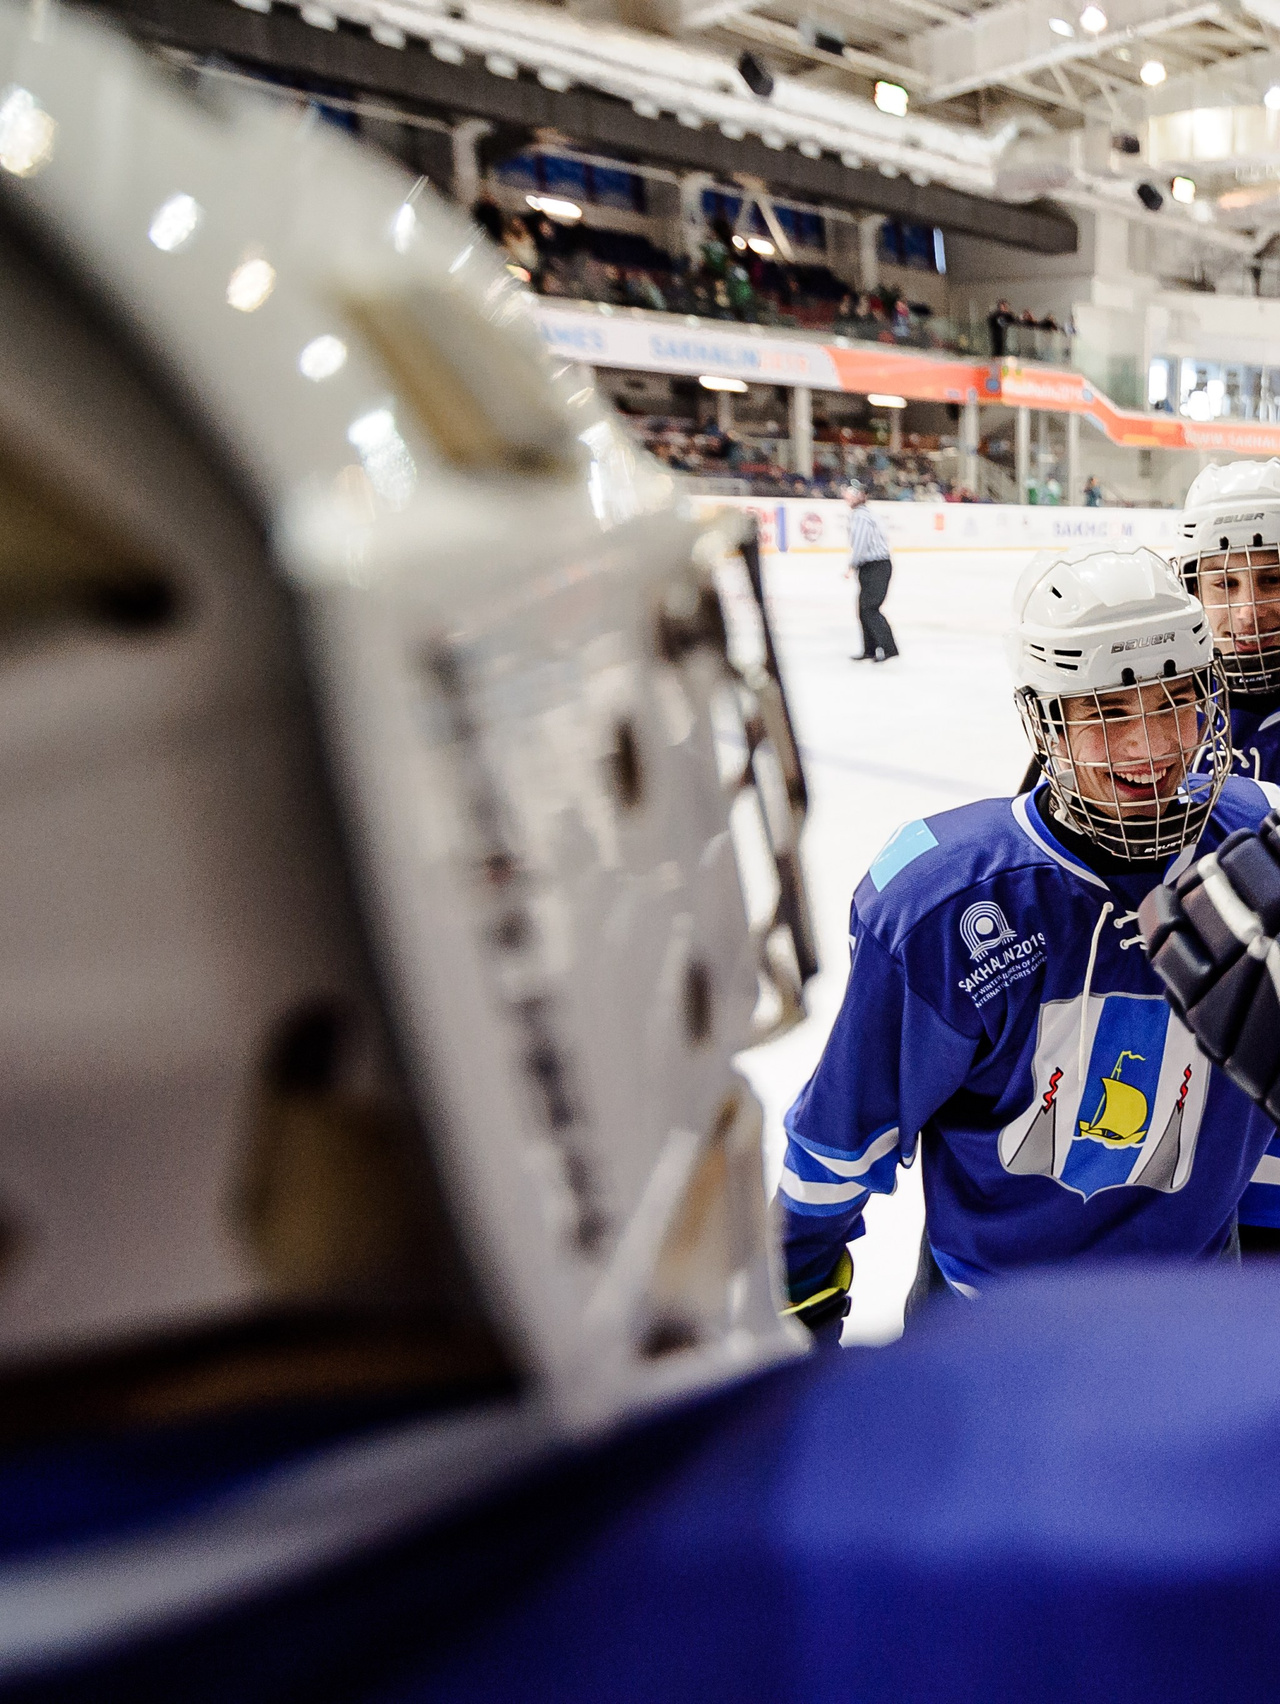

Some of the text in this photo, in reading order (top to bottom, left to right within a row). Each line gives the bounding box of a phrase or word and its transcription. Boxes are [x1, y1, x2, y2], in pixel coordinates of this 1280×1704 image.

[1213, 512, 1265, 526] BAUER
[1110, 631, 1176, 654] BAUER
[979, 975, 1002, 995] WINTER
